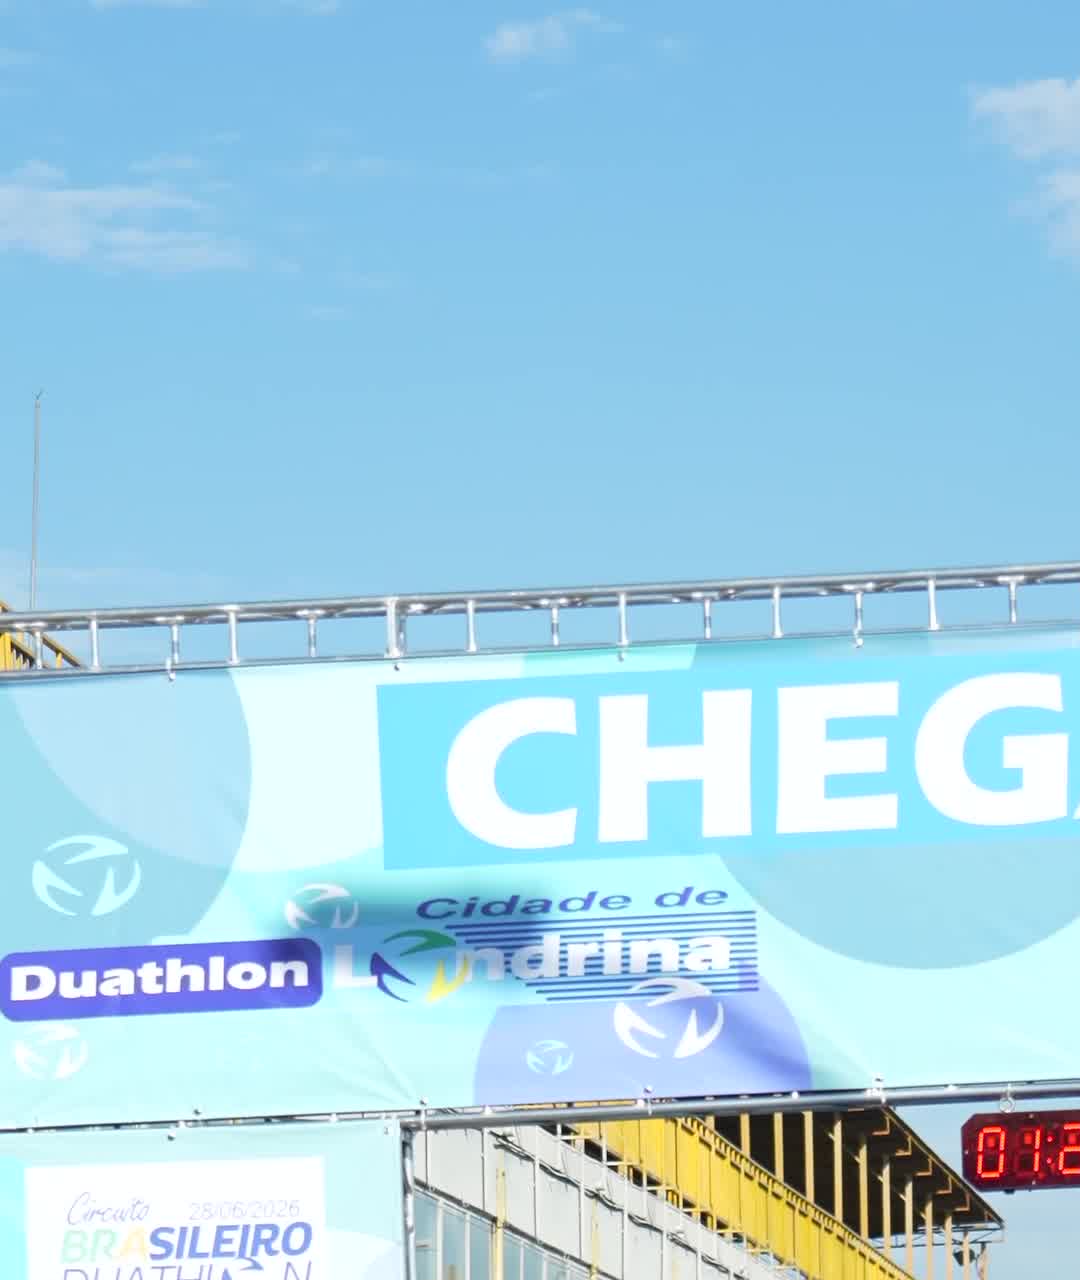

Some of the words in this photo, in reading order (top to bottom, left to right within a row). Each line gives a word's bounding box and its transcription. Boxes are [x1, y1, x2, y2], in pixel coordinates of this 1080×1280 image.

[416, 890, 632, 920] Cidade
[654, 886, 729, 909] de
[9, 953, 310, 1002] Duathlon
[67, 1191, 150, 1225] Circuito
[189, 1199, 300, 1221] 28/06/2026
[60, 1221, 312, 1264] BRASILEIRO
